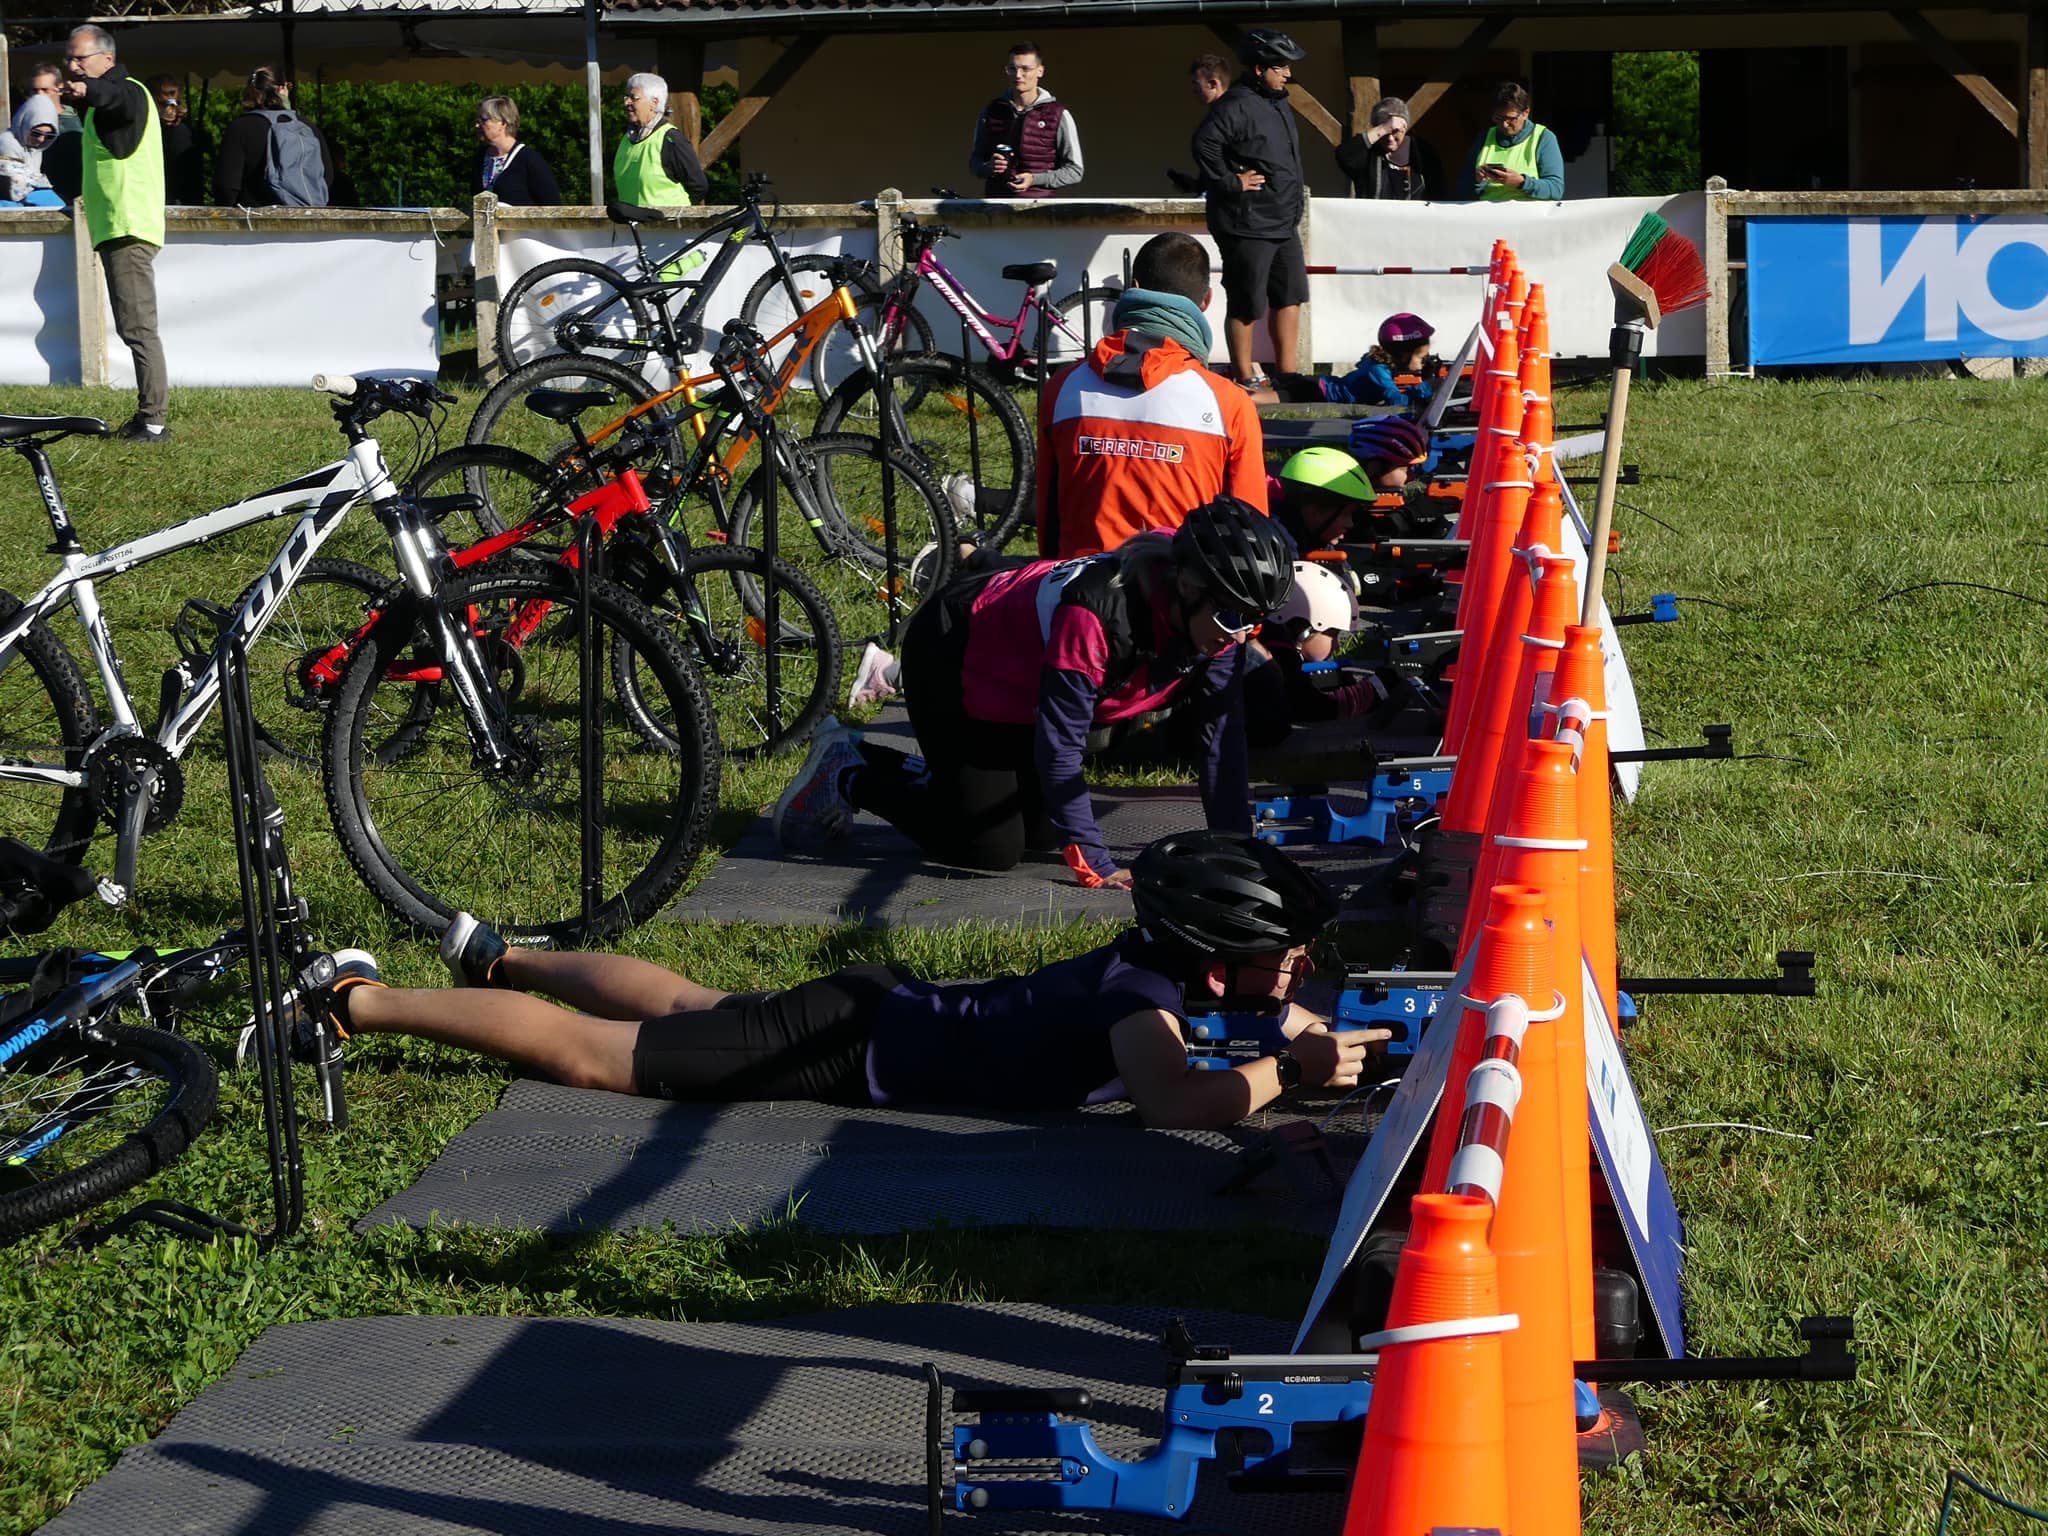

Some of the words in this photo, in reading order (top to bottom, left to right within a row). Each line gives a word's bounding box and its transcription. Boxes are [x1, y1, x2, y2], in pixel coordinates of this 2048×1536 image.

[1413, 779, 1422, 790] 5
[1404, 998, 1416, 1013] 3
[1258, 1393, 1274, 1414] 2
